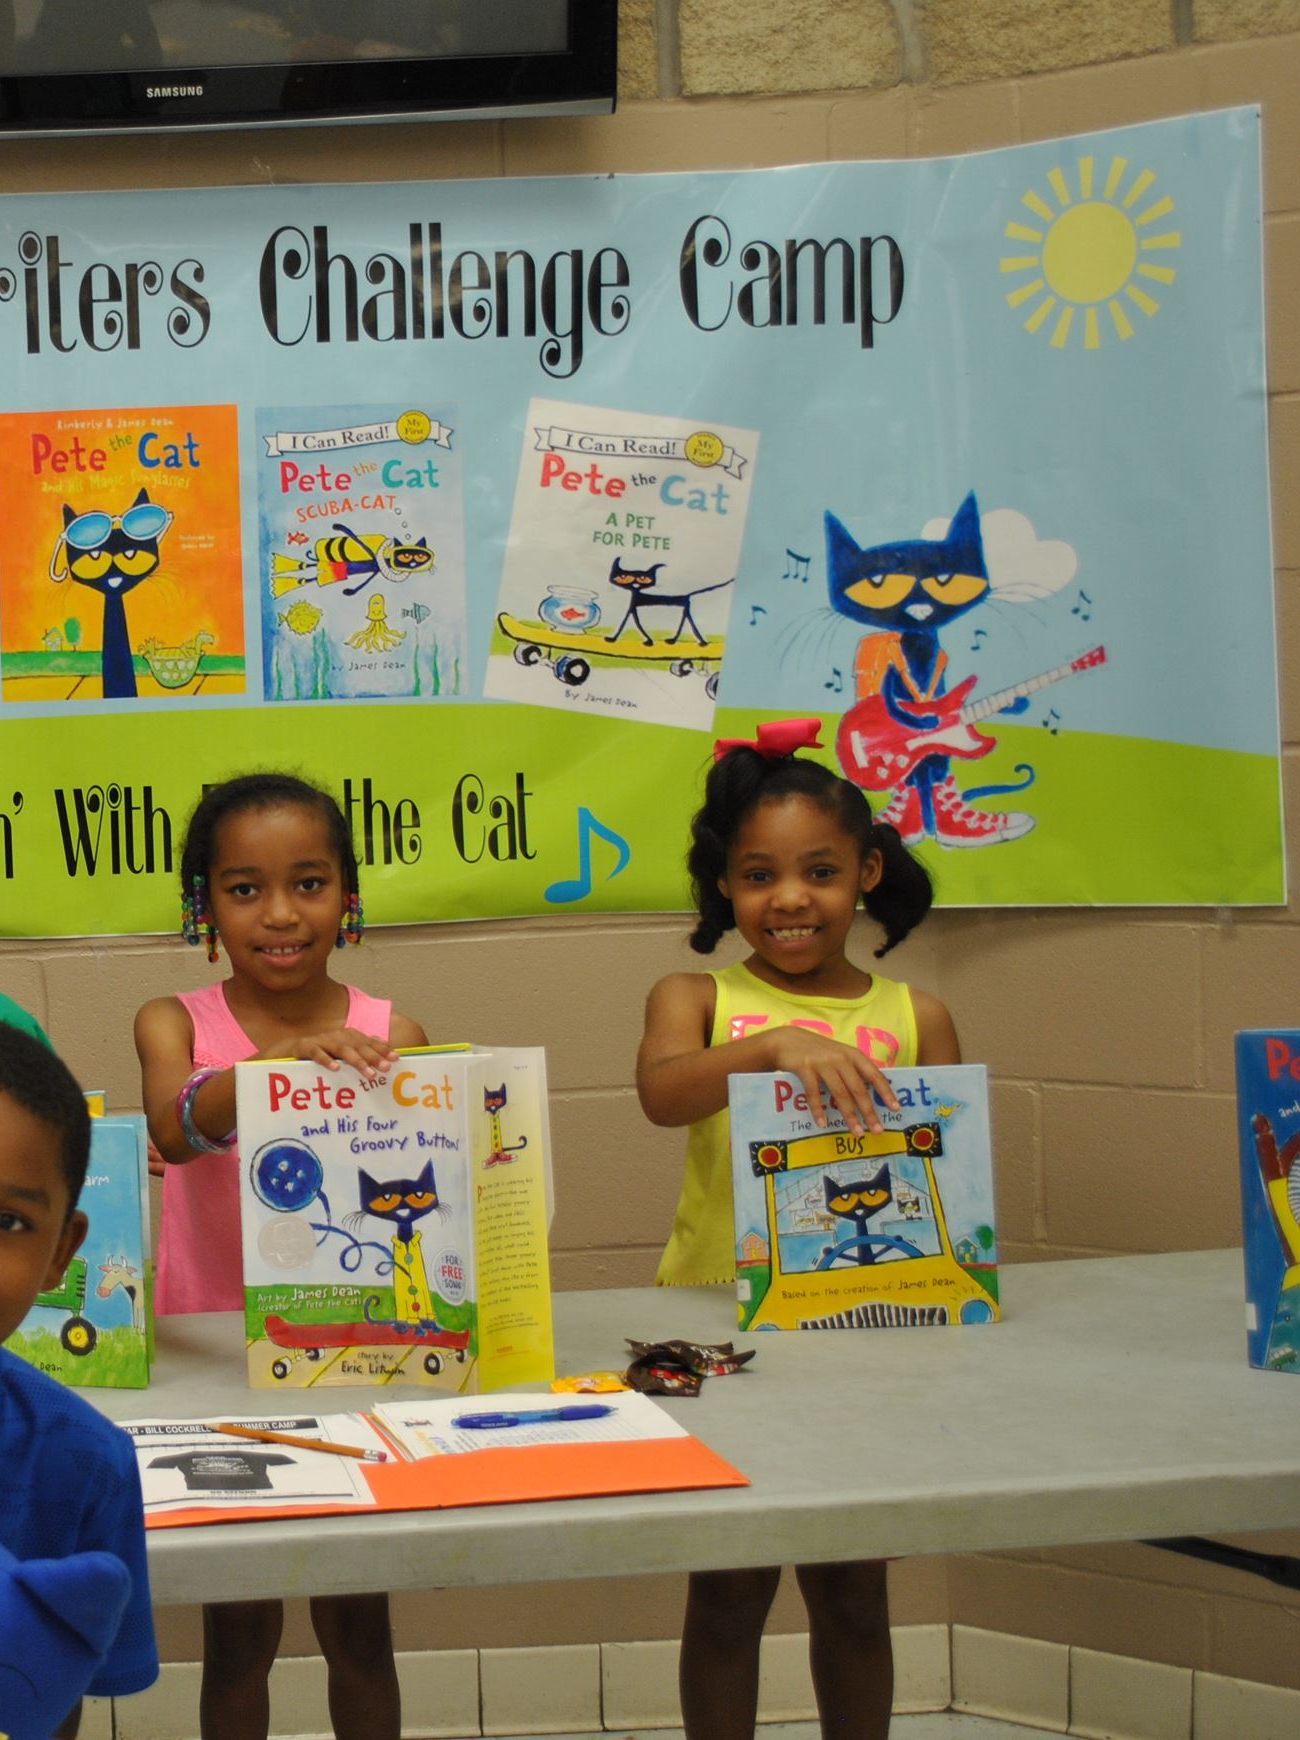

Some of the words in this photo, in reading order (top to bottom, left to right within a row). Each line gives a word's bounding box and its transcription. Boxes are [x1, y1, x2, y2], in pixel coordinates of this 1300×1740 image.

[146, 86, 203, 98] SAMSUNG
[258, 222, 633, 380] Challenge
[679, 215, 905, 349] Camp
[291, 437, 298, 450] I
[303, 432, 337, 448] Can
[341, 426, 390, 445] Read!
[564, 434, 573, 447] I
[578, 437, 616, 453] Can
[623, 439, 677, 455] Read!
[31, 433, 107, 474] Pete
[109, 433, 133, 452] the
[138, 432, 200, 468] Cat
[279, 459, 352, 494] Pete
[353, 462, 378, 476] the
[382, 459, 440, 489] Cat
[540, 450, 627, 498] Pete
[631, 473, 657, 487] the
[659, 474, 730, 515] Cat
[295, 494, 397, 524] SCUBA-CAT
[605, 512, 618, 527] A
[626, 513, 655, 530] PET
[592, 531, 624, 547] FOR
[632, 533, 671, 550] PETE
[348, 661, 378, 671] James
[344, 778, 423, 867] the
[451, 771, 539, 865] Cat
[54, 785, 174, 878] With
[268, 1072, 356, 1112] Pete
[360, 1076, 387, 1092] the
[392, 1071, 454, 1110] Cat
[301, 1119, 329, 1136] and
[338, 1115, 358, 1133] His
[367, 1116, 398, 1131] Four
[790, 1120, 812, 1132] The
[882, 1111, 903, 1123] the
[350, 1136, 409, 1154] Groovy
[417, 1131, 459, 1151] Buttons
[835, 1135, 864, 1154] BUS
[84, 1175, 110, 1186] arm
[445, 1255, 458, 1264] FOR
[441, 1265, 462, 1280] FREE
[444, 1279, 461, 1289] SONG
[898, 1280, 927, 1290] James
[932, 1278, 956, 1287] Dean
[258, 1294, 272, 1302] Art
[276, 1294, 287, 1303] by
[292, 1287, 327, 1301] James
[332, 1286, 361, 1296] Dean
[40, 1361, 62, 1371] Dean
[341, 1359, 362, 1373] Eric
[369, 1362, 405, 1374] Litwin
[145, 1426, 164, 1434] BILL
[272, 1421, 297, 1429] CAMP
